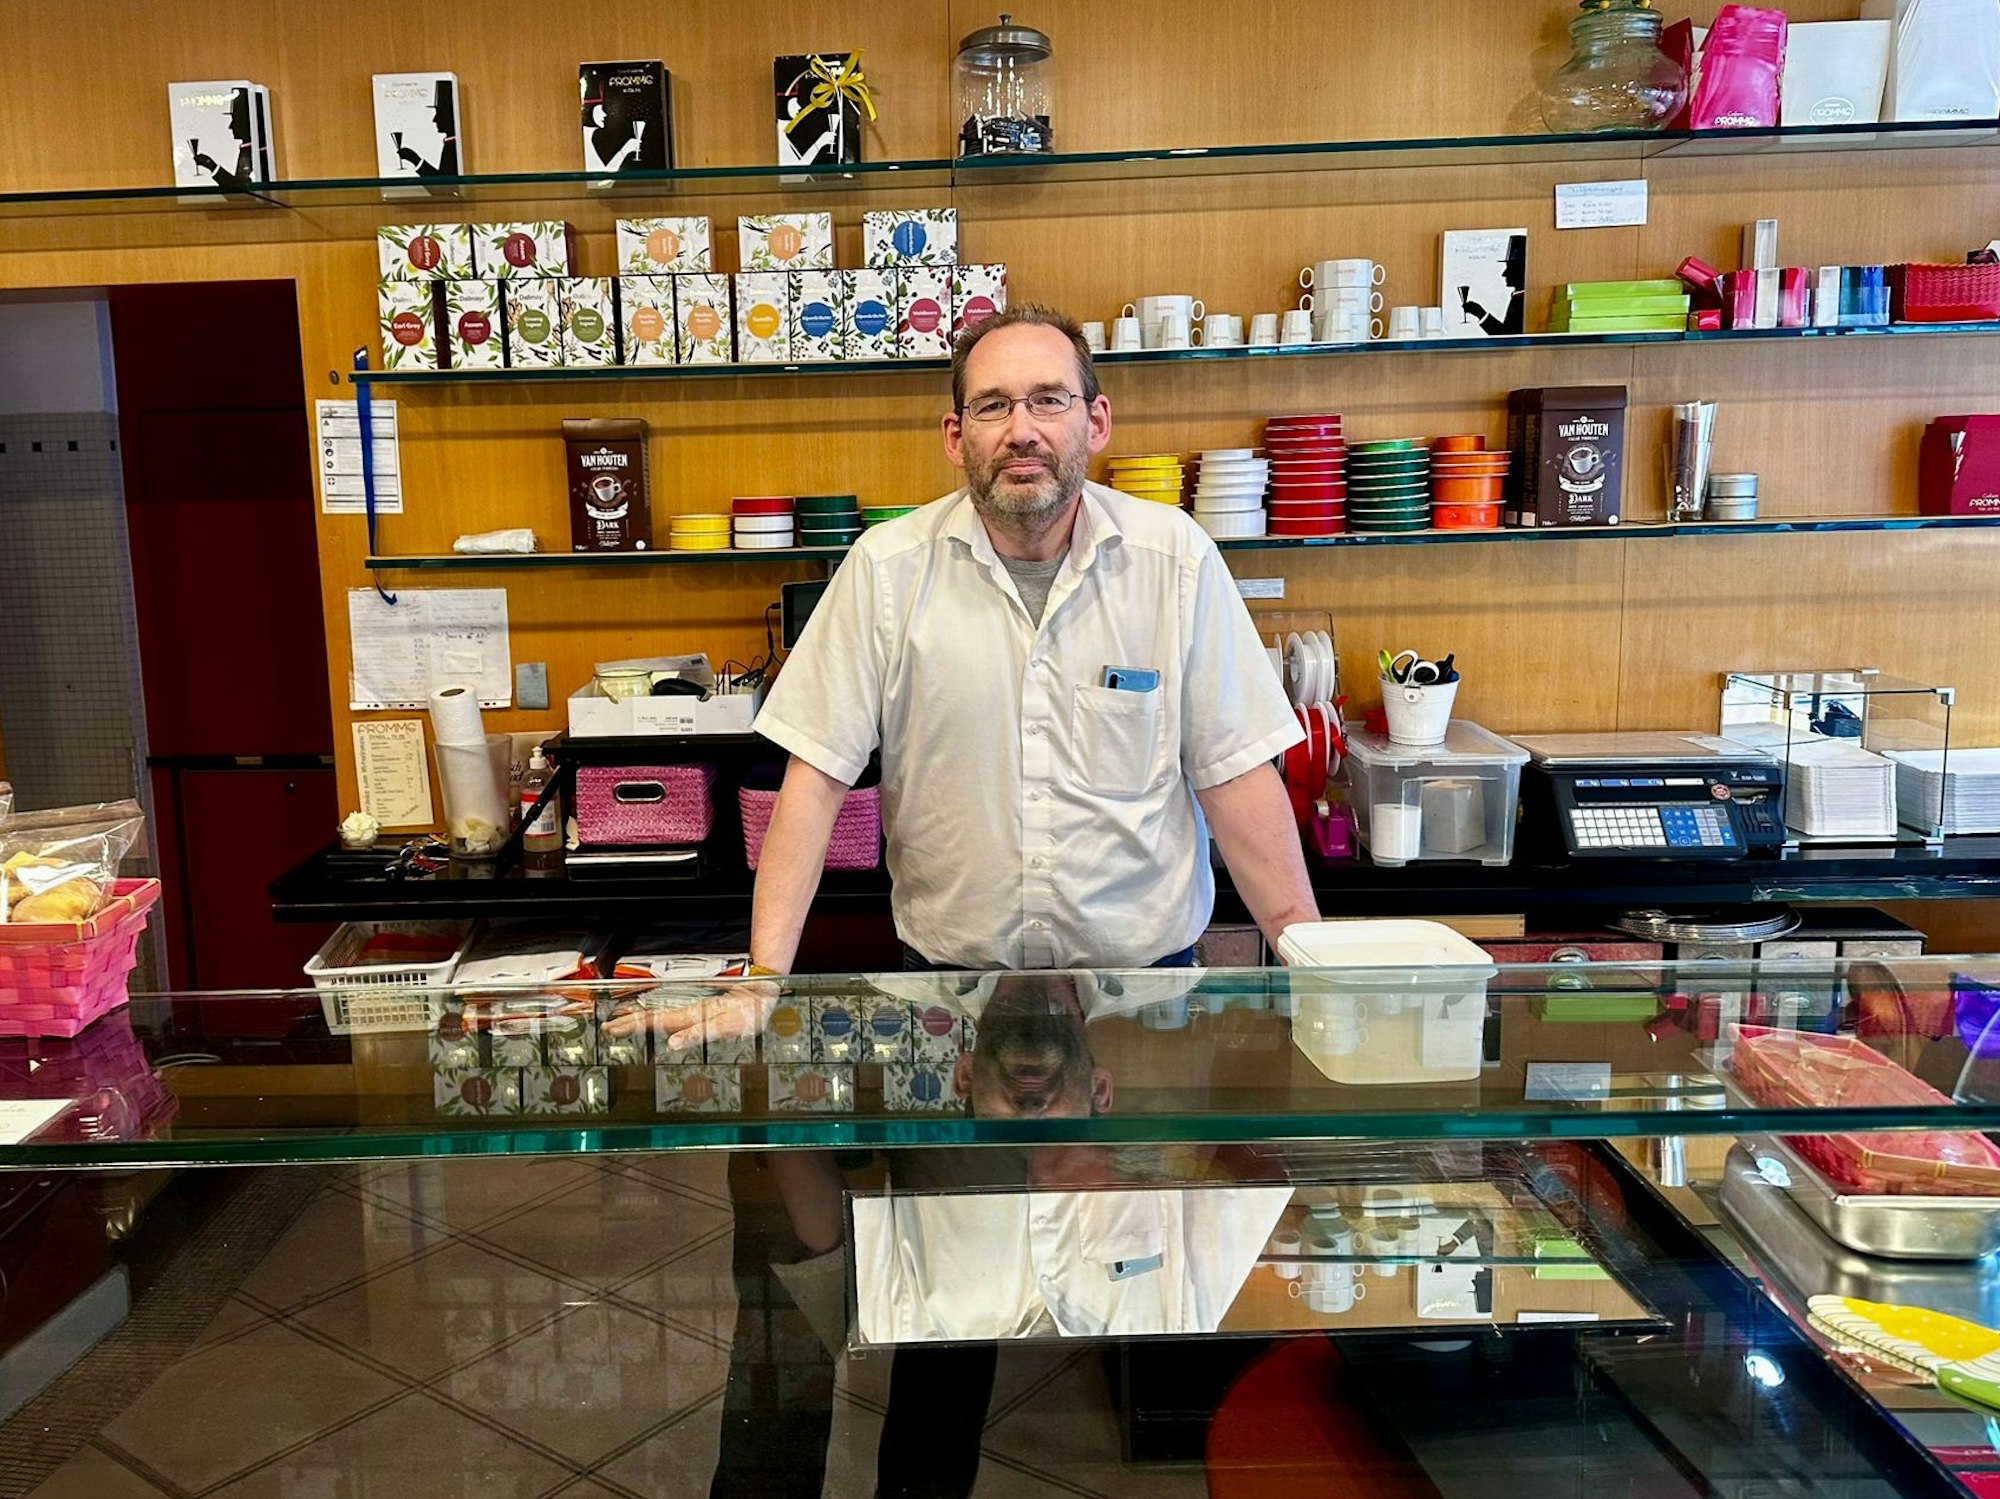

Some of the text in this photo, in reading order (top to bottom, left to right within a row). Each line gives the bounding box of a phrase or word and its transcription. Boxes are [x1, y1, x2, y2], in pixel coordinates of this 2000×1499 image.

[393, 321, 421, 330] Earl Grey
[1558, 423, 1609, 438] VAN HOUTEN
[580, 453, 629, 468] VAN HOUTEN
[357, 722, 417, 734] FROMME
